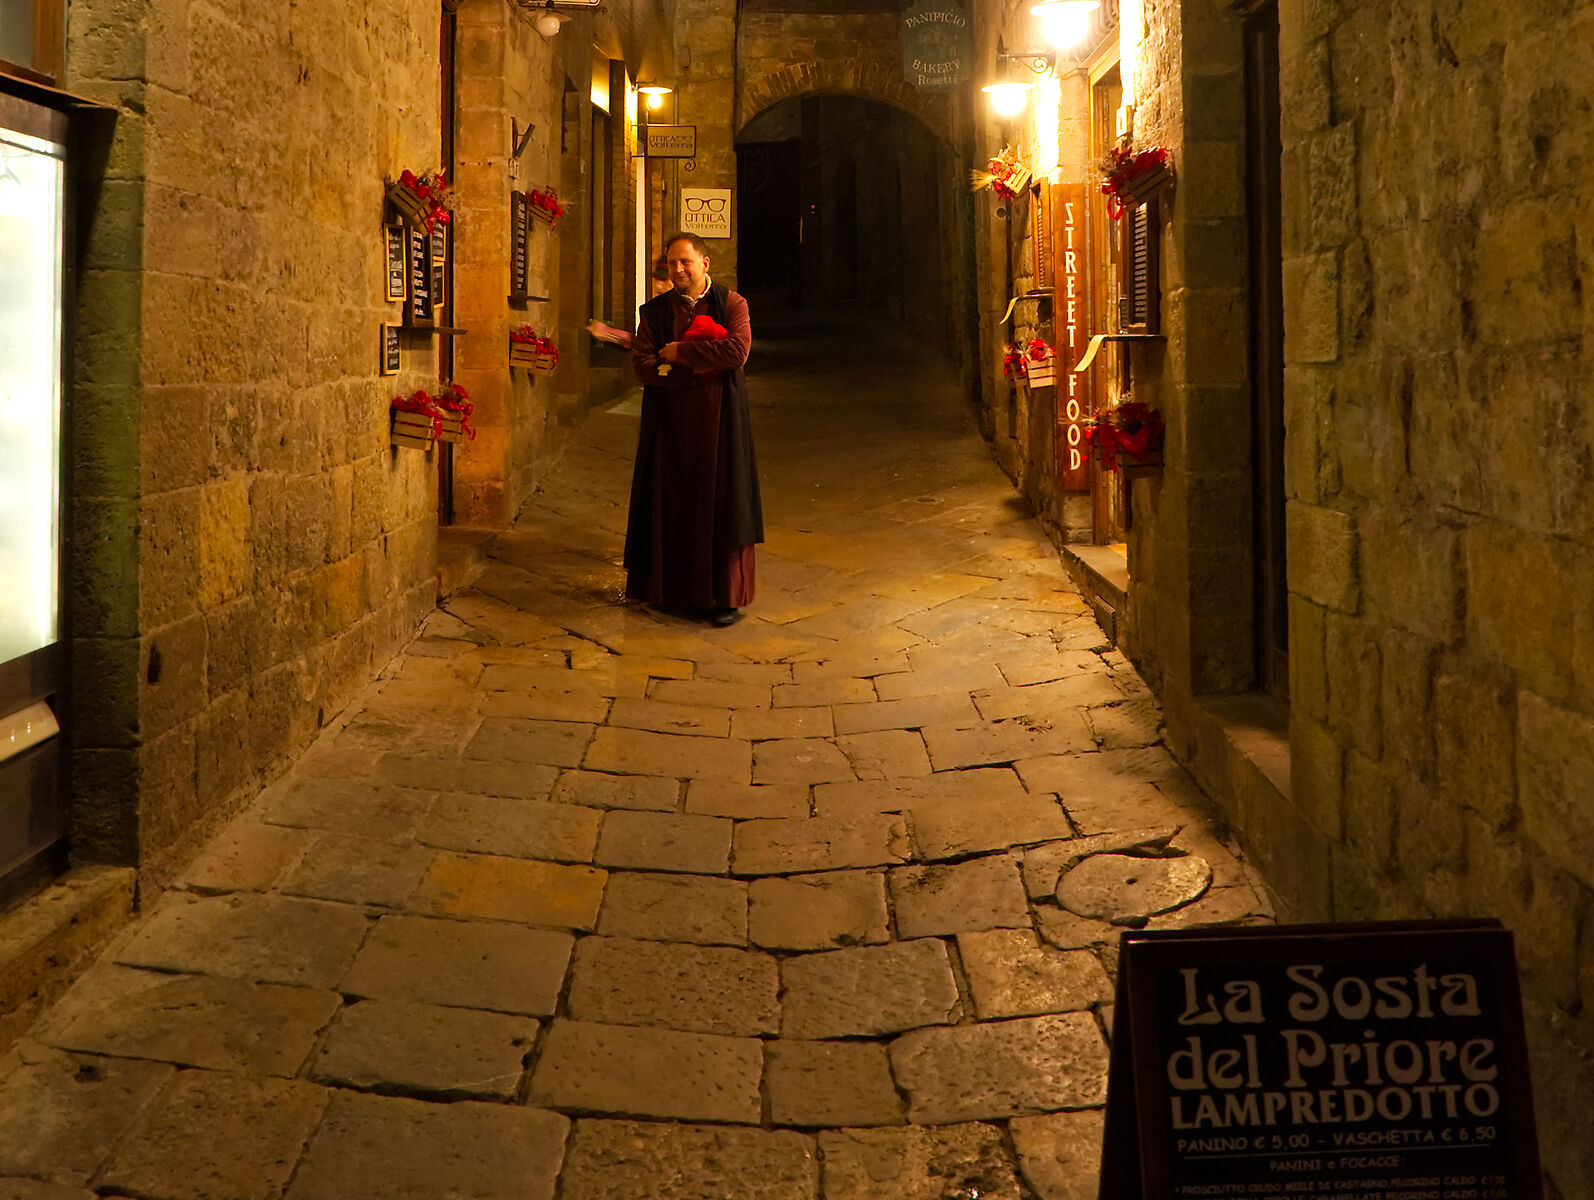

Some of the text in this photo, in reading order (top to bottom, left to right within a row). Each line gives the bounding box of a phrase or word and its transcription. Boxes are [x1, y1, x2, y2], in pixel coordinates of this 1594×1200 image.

[912, 58, 960, 74] BAKERY
[685, 213, 725, 223] OTTICA
[1064, 202, 1077, 349] STREET
[1066, 374, 1081, 471] FOOD
[1177, 963, 1482, 1027] La Sosta
[1167, 1029, 1499, 1091] del Priore
[1170, 1082, 1501, 1131] LAMPREDOTTO
[1177, 1136, 1249, 1153] PANINO
[1253, 1135, 1266, 1149] €
[1332, 1129, 1435, 1147] VASCHETTA
[1440, 1127, 1453, 1141] €
[1270, 1158, 1322, 1172] PANINI
